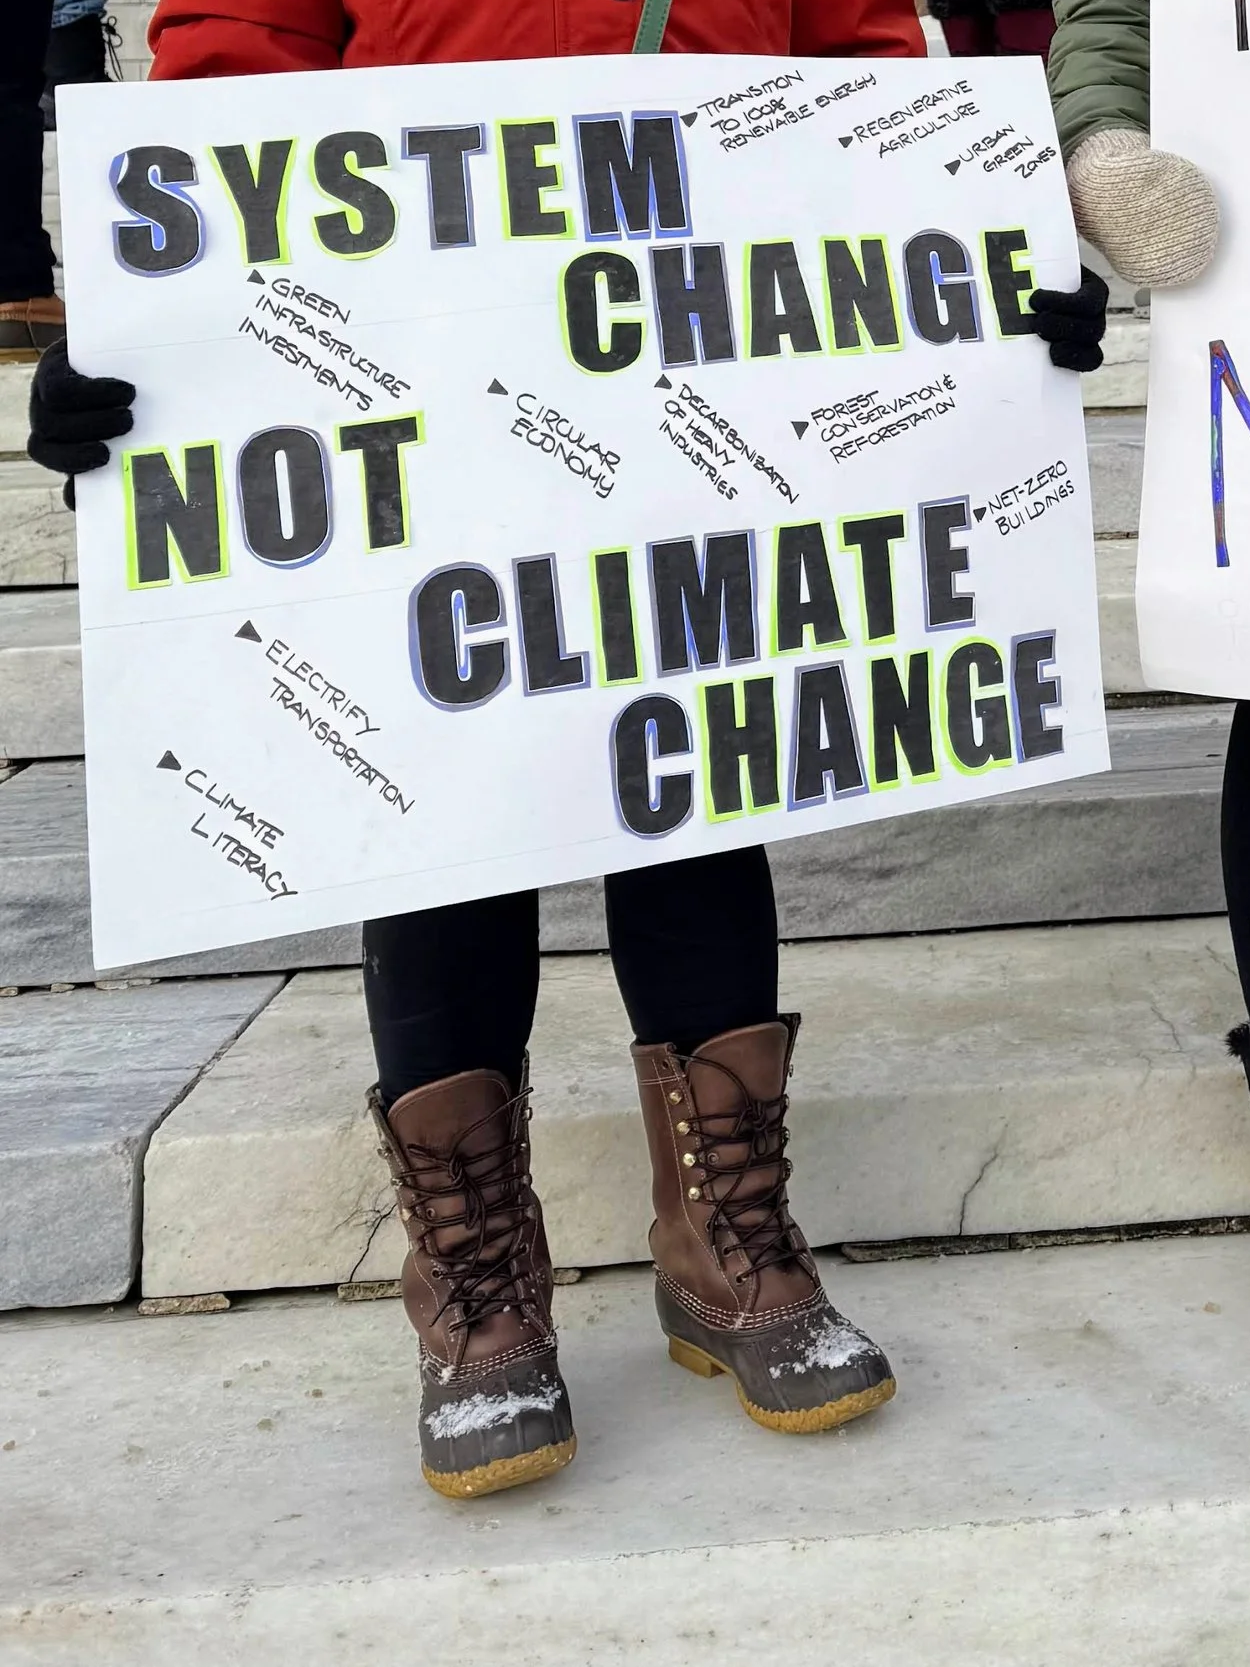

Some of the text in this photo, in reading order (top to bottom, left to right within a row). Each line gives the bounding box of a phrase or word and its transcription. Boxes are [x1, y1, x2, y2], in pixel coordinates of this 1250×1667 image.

[697, 70, 804, 118] TRANSITION
[711, 96, 787, 136] TO 100%
[720, 72, 877, 152] RENEWABLE ENERGY
[853, 79, 973, 143] REGENERATIVE
[878, 101, 980, 159] AGRICULTURE
[959, 124, 1016, 163] URBAN
[982, 135, 1034, 173] GREEN
[1014, 145, 1058, 179] ZONES
[110, 112, 691, 277] SYSTEM
[271, 277, 351, 324] GREEN
[562, 227, 1038, 374] CHANGE
[238, 316, 373, 411] INVESTMENTS
[255, 294, 411, 399] INFRASTRUCTURE
[516, 392, 621, 474] CIRCULAR
[664, 399, 736, 466] OF HEAVY
[678, 383, 799, 504] DECARBONIZATION
[811, 390, 879, 425] FOREST
[820, 380, 944, 443] CONSERVATION
[829, 396, 956, 464] REFORESTATION
[510, 417, 615, 498] ECONOMY
[659, 419, 738, 501] INDUSTRIES
[987, 460, 1068, 515] NET-ZERO
[125, 414, 424, 588] NOT
[995, 480, 1075, 536] BUILDINGS
[410, 496, 976, 711] CLIMATE
[265, 639, 381, 736] ELECTRIFY
[270, 677, 415, 814] TRANSPORTATION
[610, 629, 1064, 839] CHANGE
[184, 769, 285, 849] CLIMATE
[190, 812, 298, 900] LITERACY
